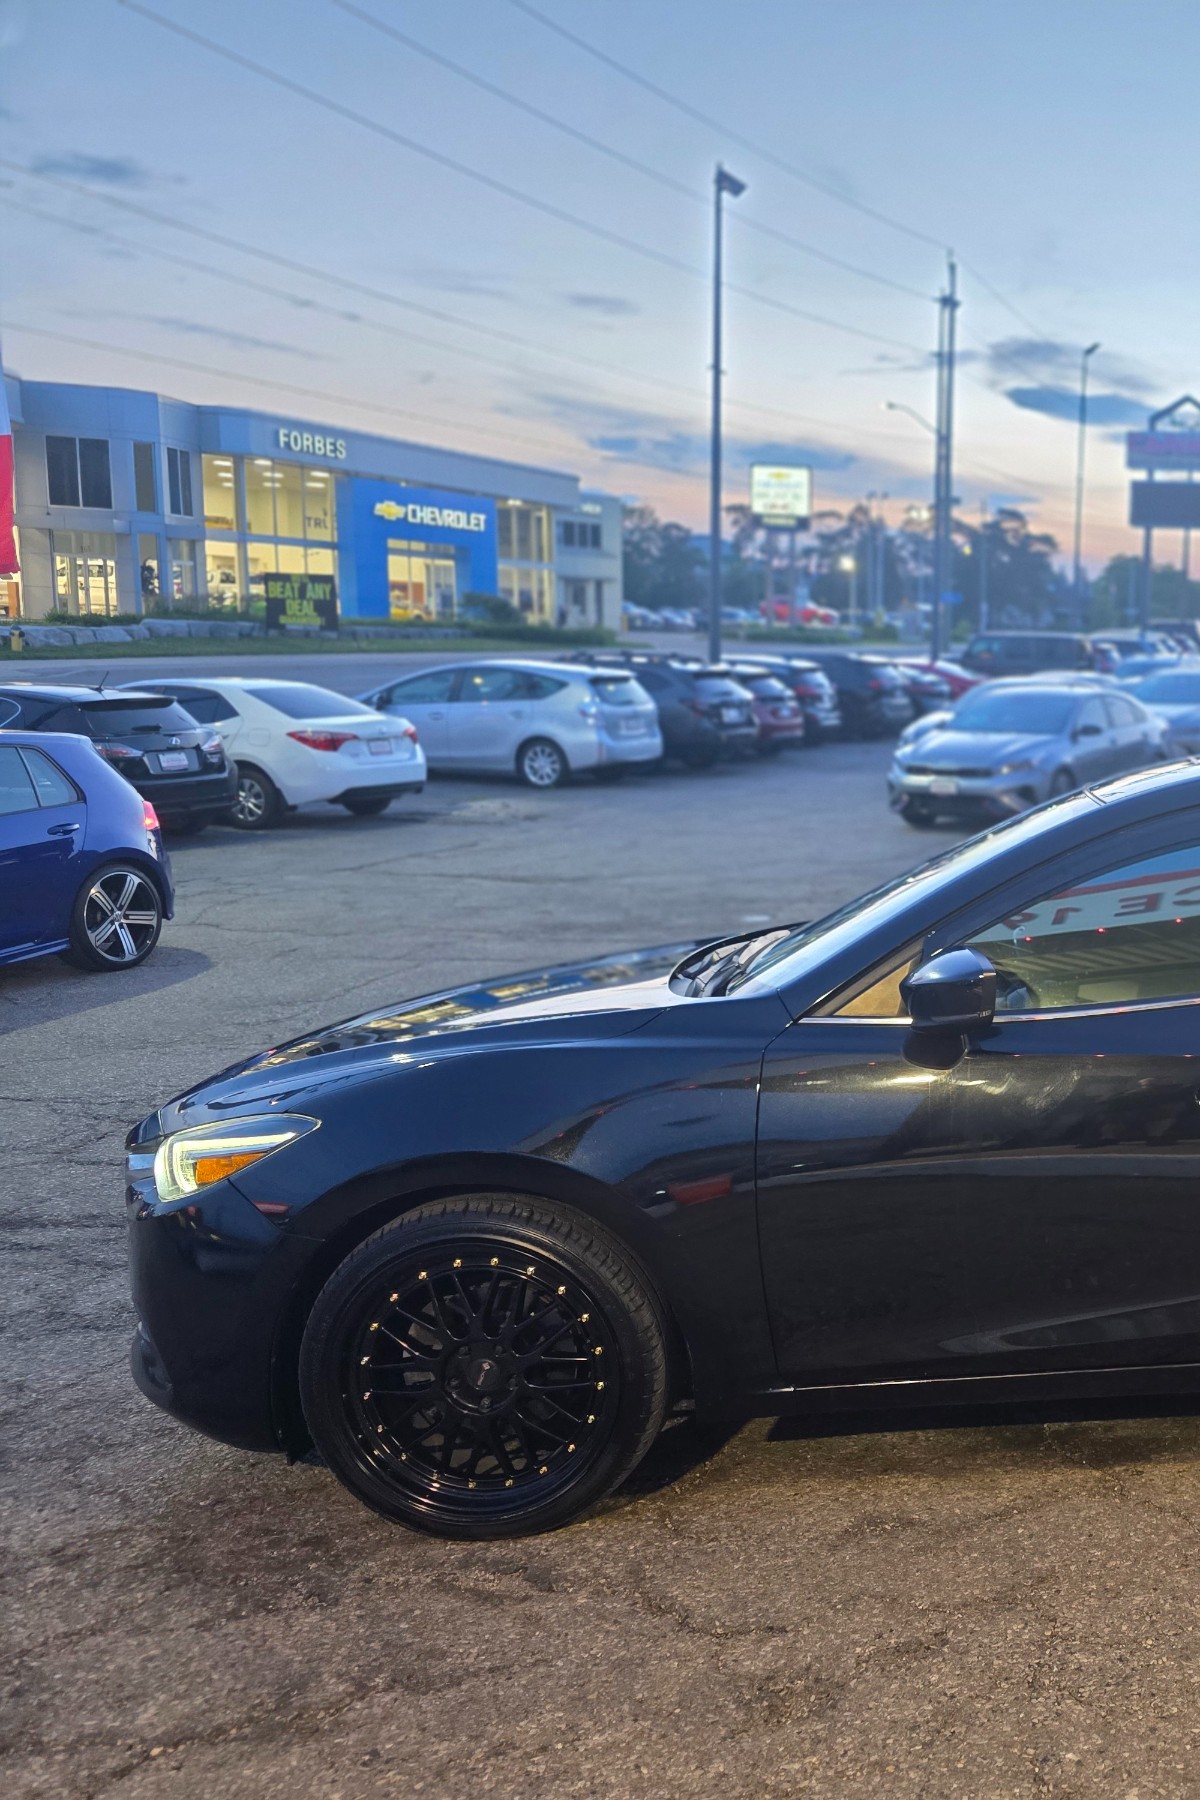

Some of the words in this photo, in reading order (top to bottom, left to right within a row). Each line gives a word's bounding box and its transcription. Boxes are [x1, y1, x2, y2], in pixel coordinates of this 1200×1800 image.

[279, 428, 347, 460] FORBES
[407, 503, 487, 532] CHEVROLET
[267, 580, 299, 599] BEAT
[306, 582, 332, 600] ANY
[286, 599, 318, 617] DEAL
